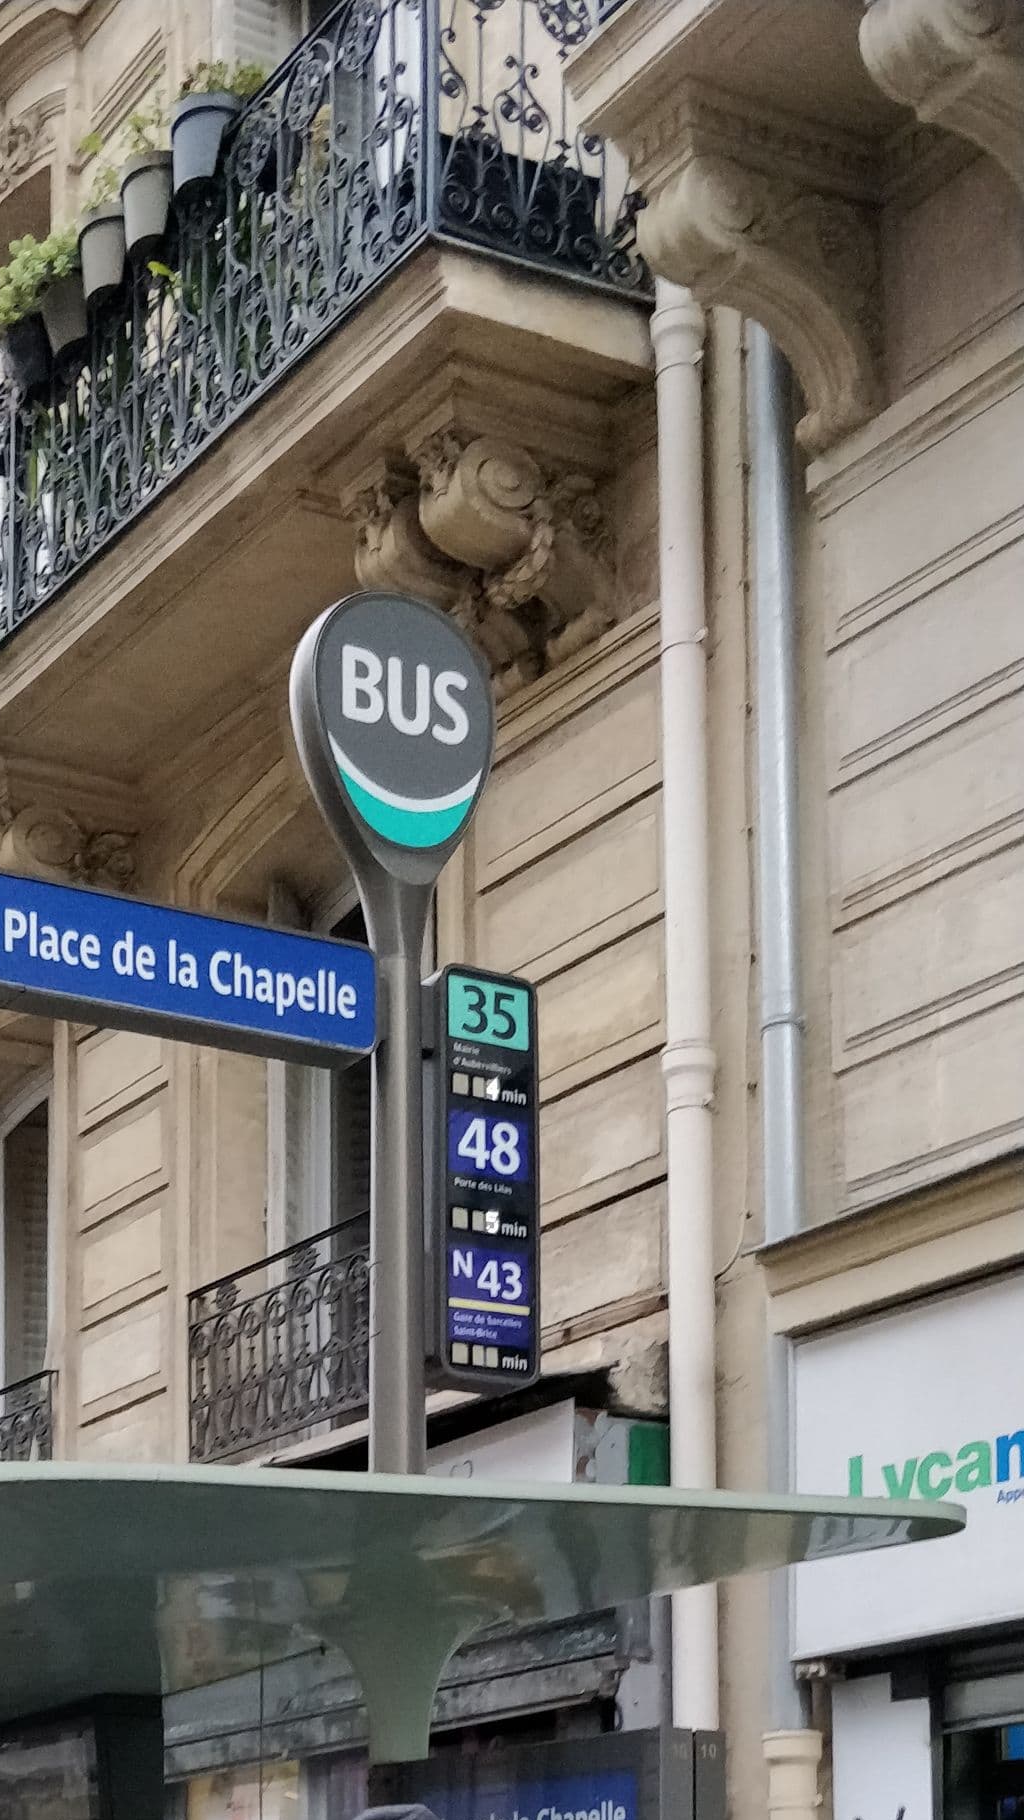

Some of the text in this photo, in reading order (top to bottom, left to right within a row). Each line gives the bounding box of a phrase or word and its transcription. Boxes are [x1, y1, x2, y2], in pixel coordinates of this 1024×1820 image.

[341, 644, 470, 745] BUS
[3, 907, 358, 1019] Place de la Chapelle
[461, 984, 517, 1041] 35
[501, 1089, 527, 1106] min
[457, 1117, 521, 1176] 48
[501, 1221, 527, 1239] min
[452, 1249, 523, 1301] N 43
[502, 1354, 528, 1371] min
